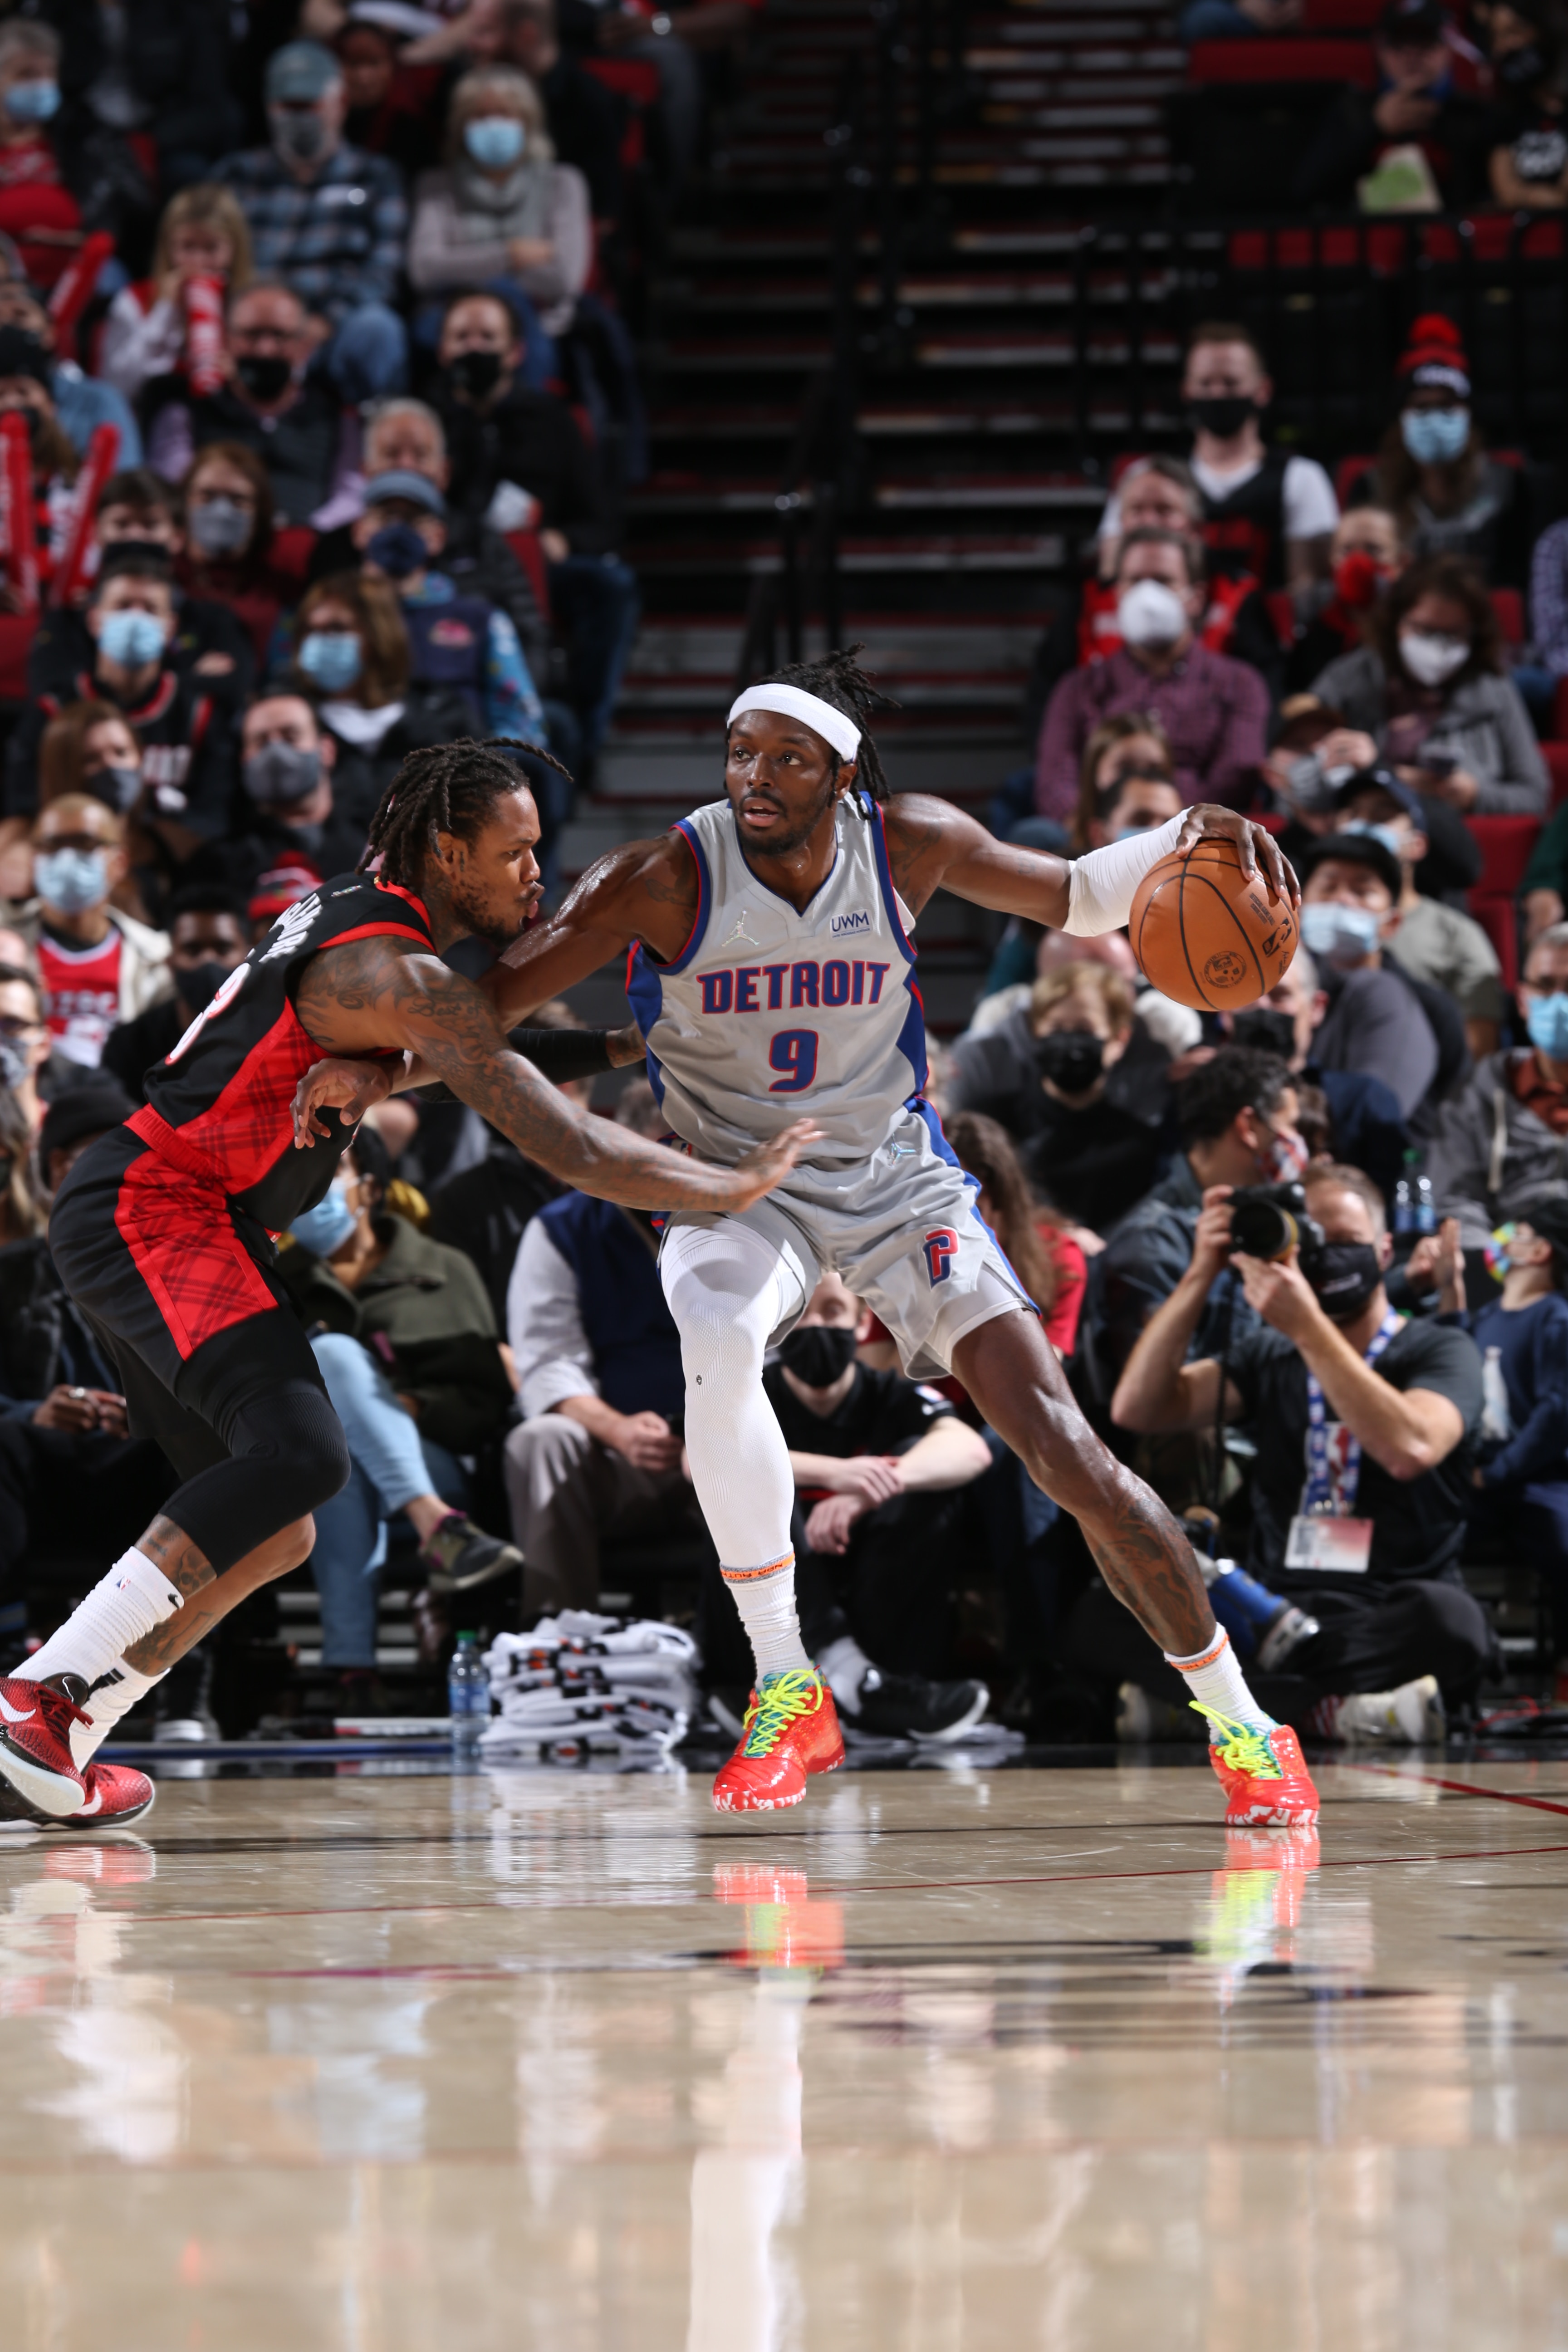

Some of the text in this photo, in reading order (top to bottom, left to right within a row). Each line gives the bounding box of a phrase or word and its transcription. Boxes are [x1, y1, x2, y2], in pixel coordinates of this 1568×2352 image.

[832, 911, 869, 932] UWM
[696, 960, 891, 1014] DETROIT
[407, 996, 461, 1017] Best
[769, 1029, 818, 1093] 9
[758, 1564, 783, 1575] NBA
